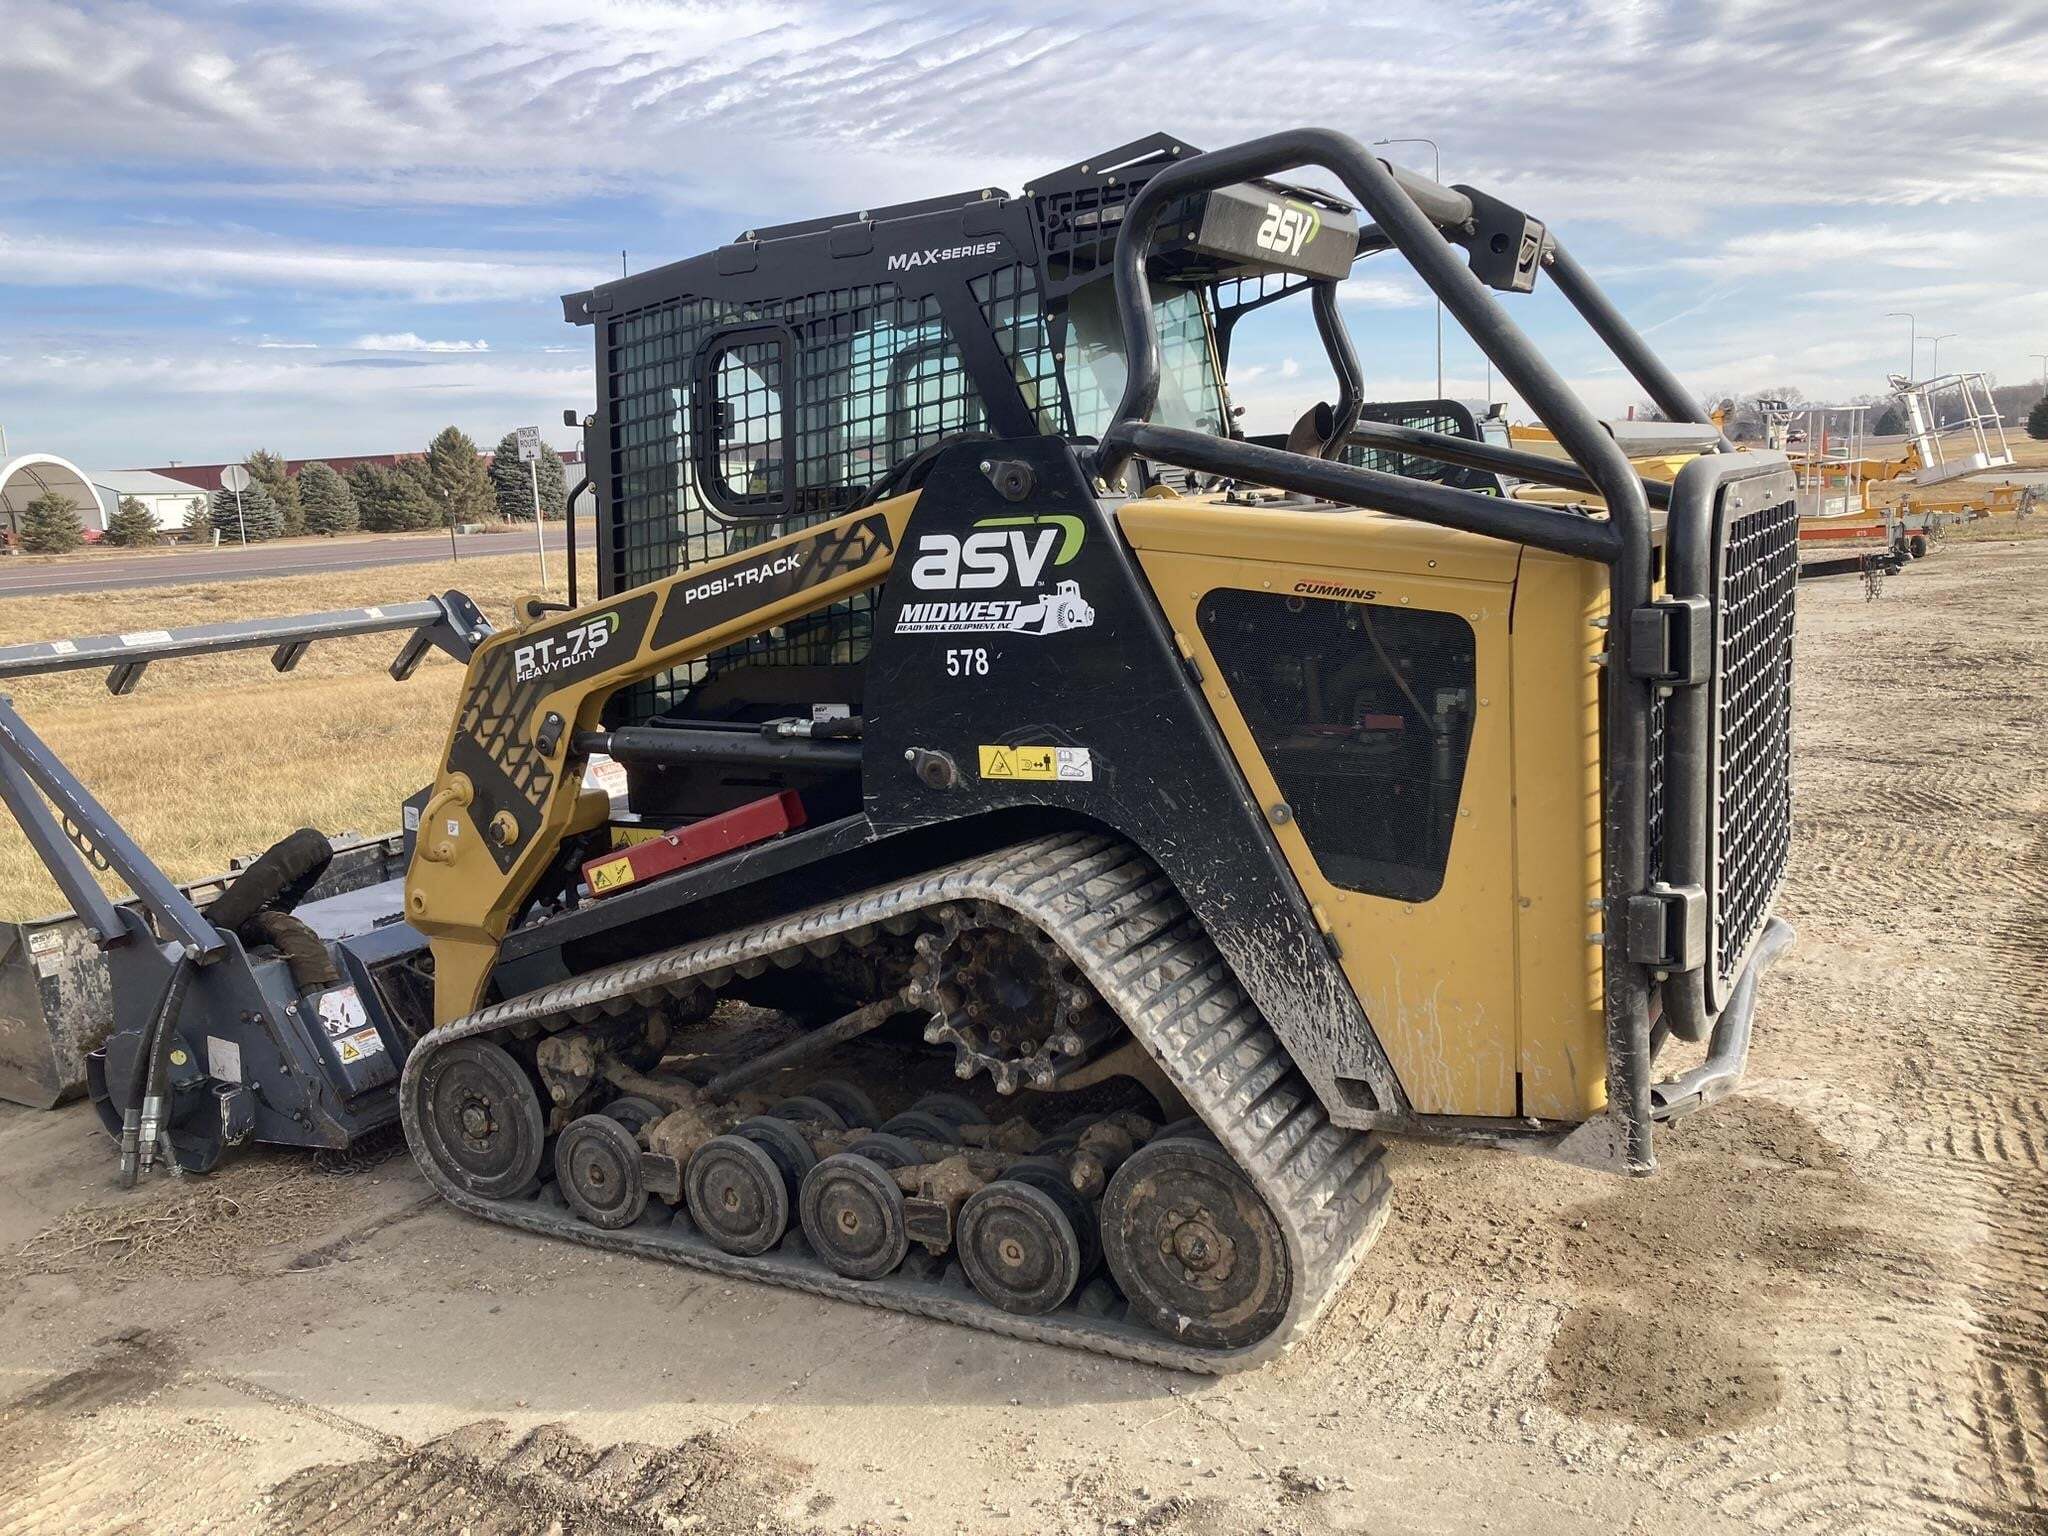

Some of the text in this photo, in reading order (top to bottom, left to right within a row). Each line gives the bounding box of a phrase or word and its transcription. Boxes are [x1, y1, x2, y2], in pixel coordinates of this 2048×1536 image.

[1257, 203, 1312, 256] asv
[887, 242, 997, 271] MAX-SERIES
[519, 429, 538, 438] TRUCK
[520, 439, 538, 448] ROUTE
[911, 529, 1059, 590] asv
[685, 554, 801, 604] POSI-TRACK
[1294, 583, 1377, 600] CUMMINS
[898, 601, 1021, 622] MIDWEST
[897, 622, 923, 631] READY
[925, 622, 939, 631] MIX
[940, 622, 946, 631] &
[514, 620, 609, 674] RT-75
[516, 647, 598, 683] HEAVY DUTY
[946, 648, 989, 676] 578
